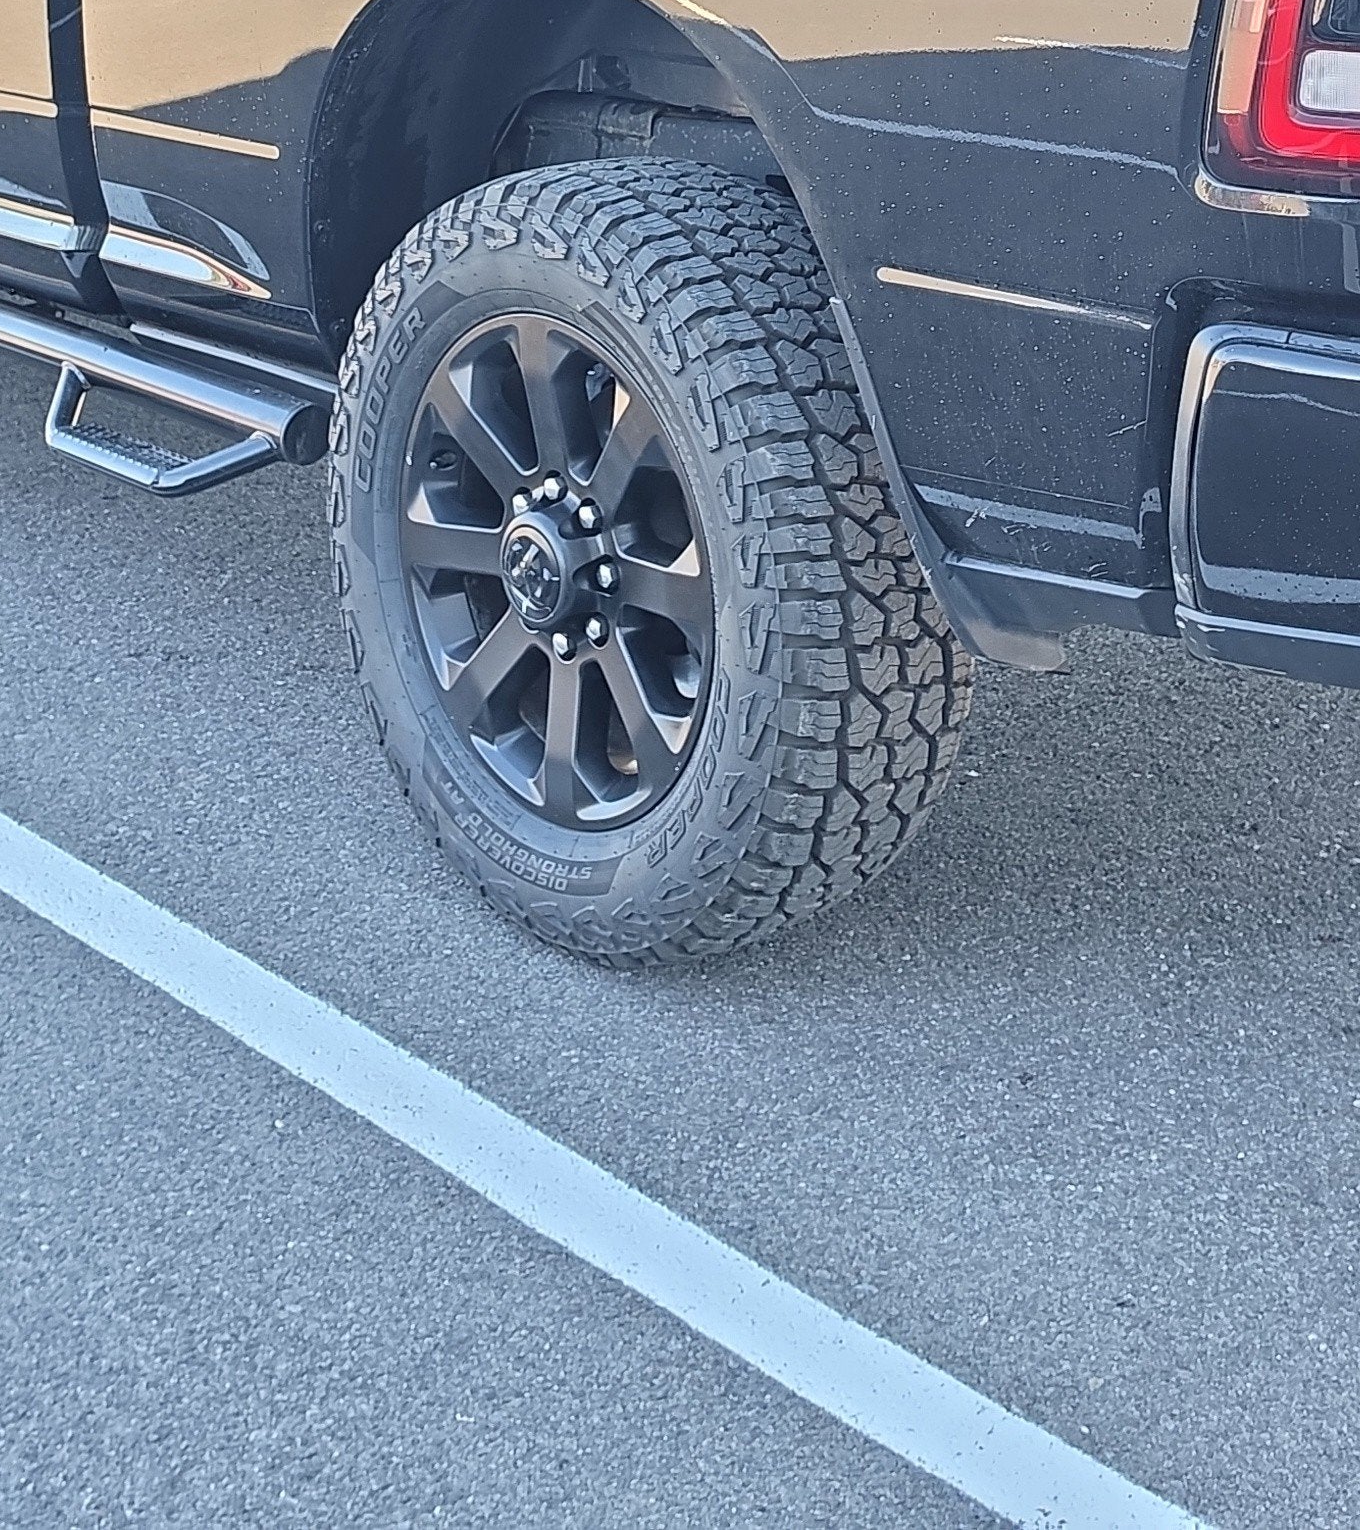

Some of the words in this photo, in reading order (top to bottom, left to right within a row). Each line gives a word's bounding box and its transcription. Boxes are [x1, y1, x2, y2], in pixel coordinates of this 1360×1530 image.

[354, 307, 425, 493] COOPER
[454, 812, 568, 891] DISCOVERER
[469, 812, 593, 880] STRONGHOLD
